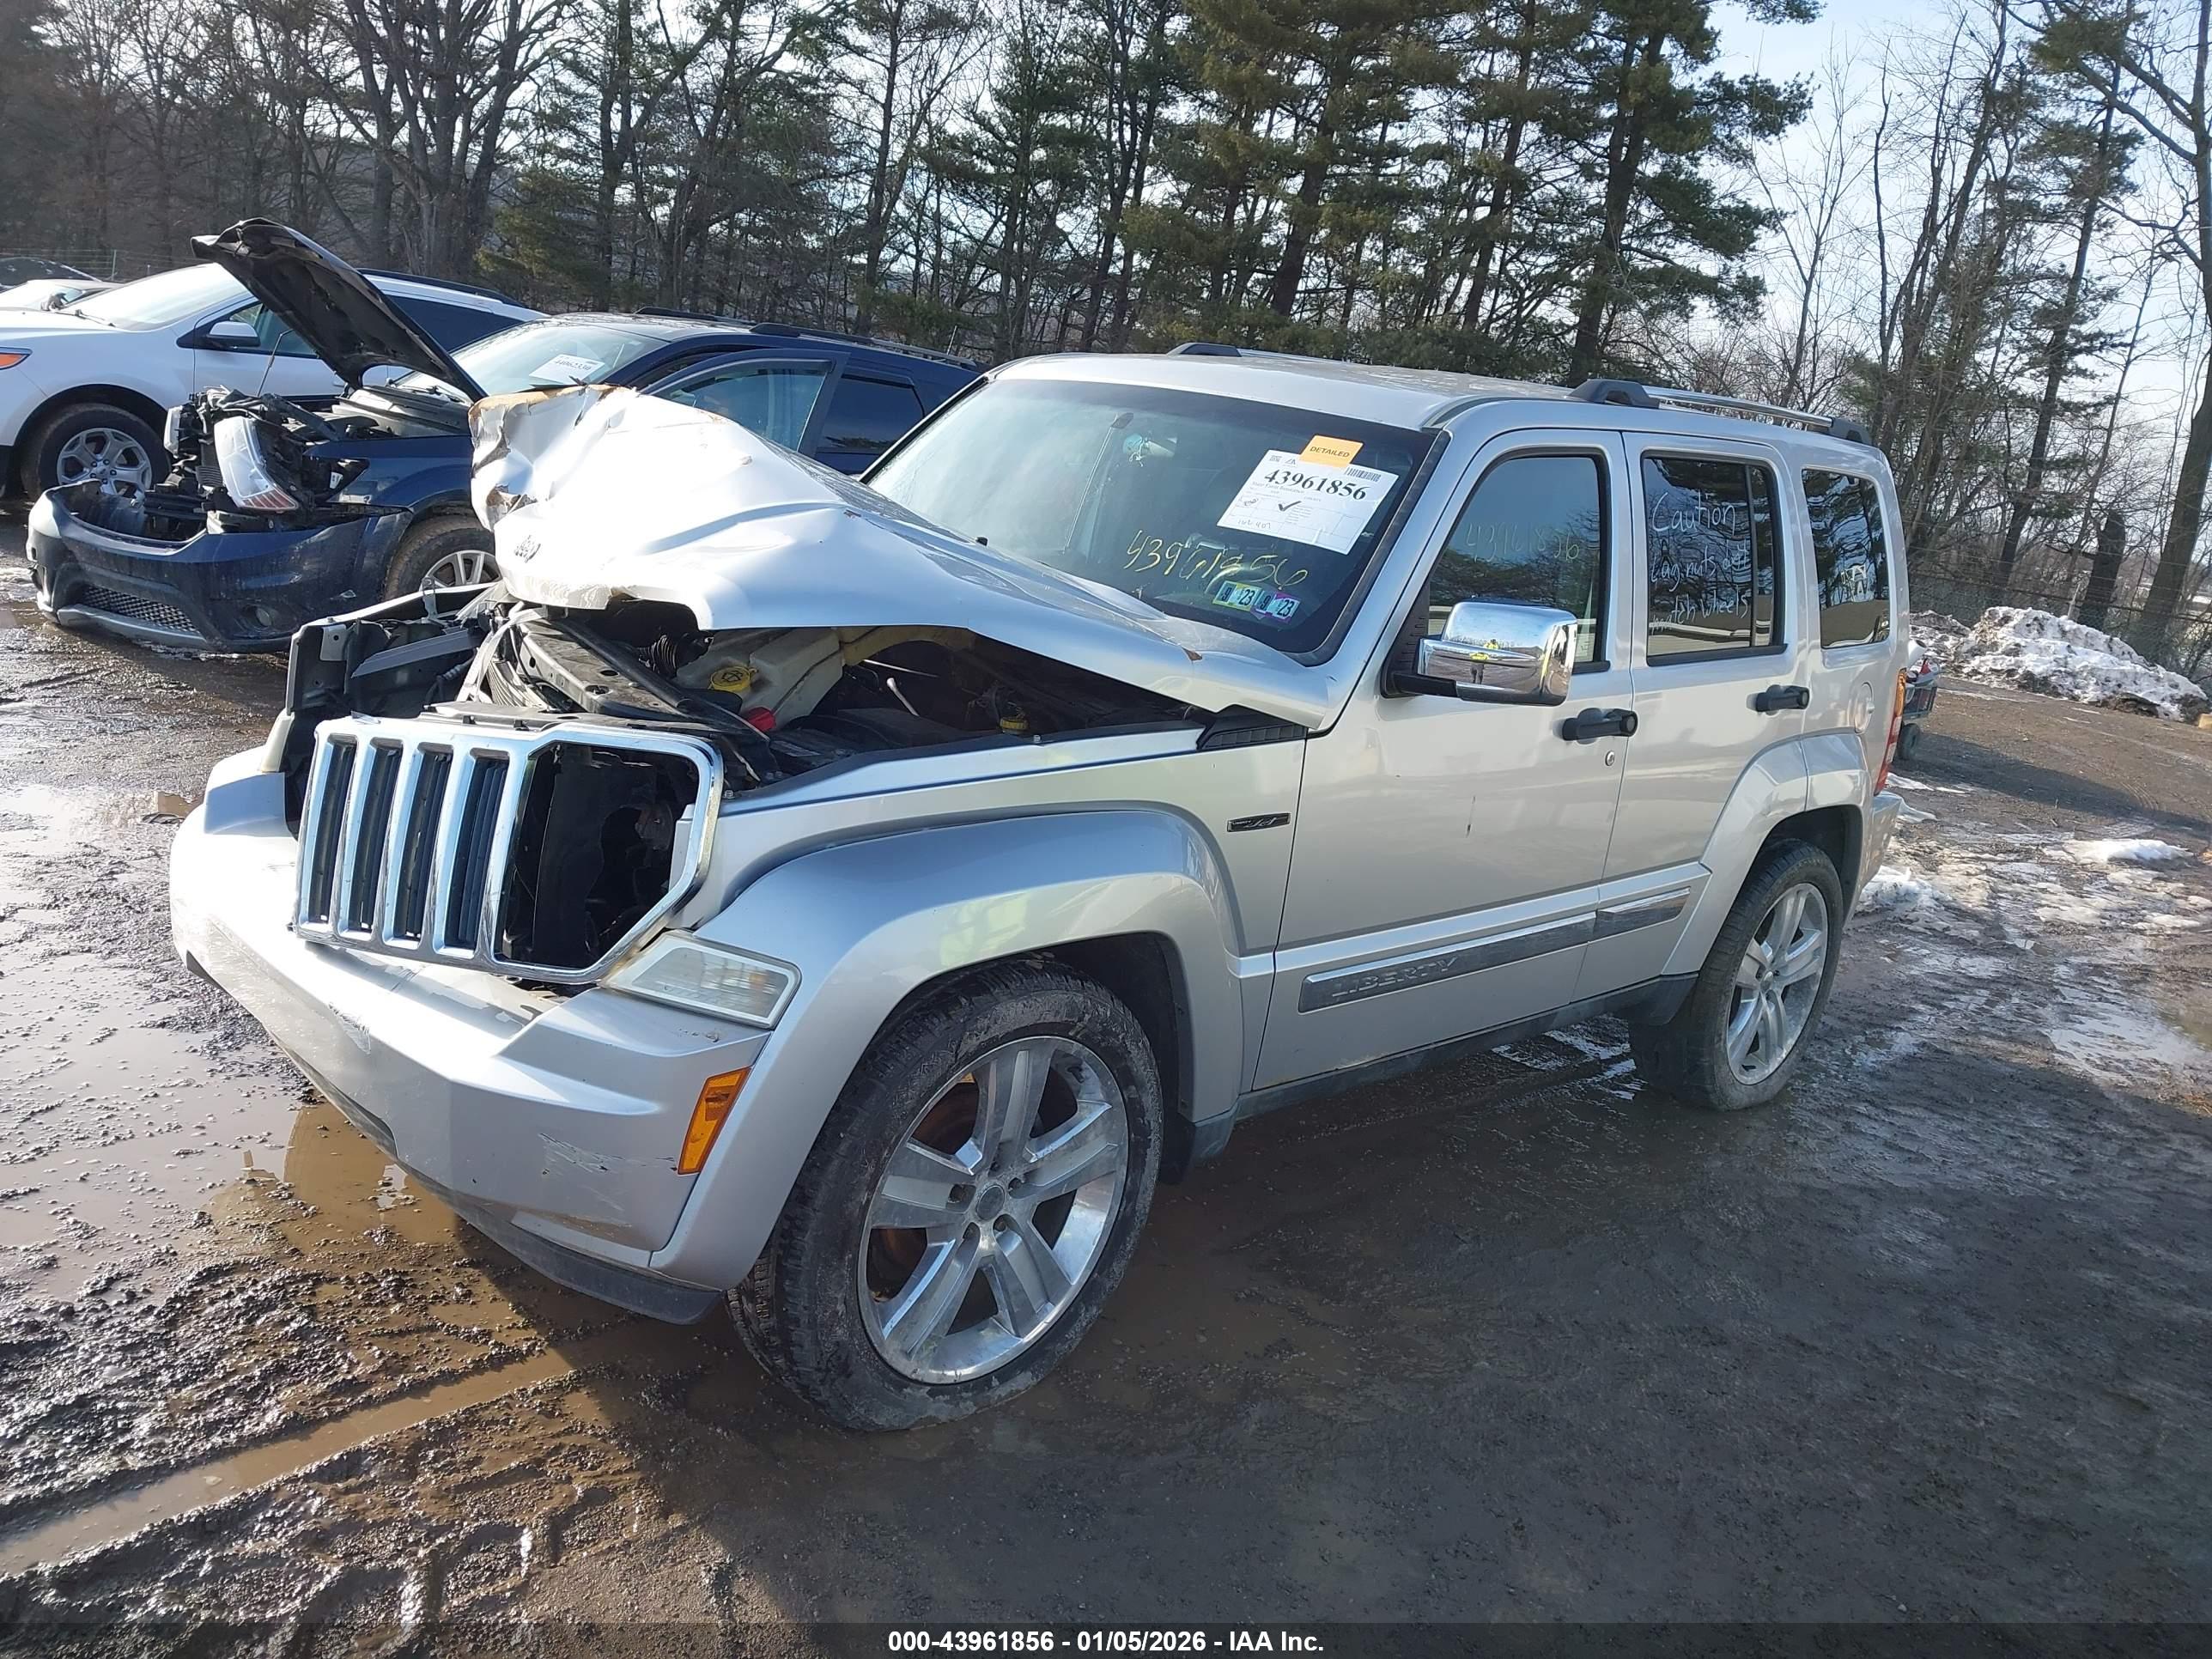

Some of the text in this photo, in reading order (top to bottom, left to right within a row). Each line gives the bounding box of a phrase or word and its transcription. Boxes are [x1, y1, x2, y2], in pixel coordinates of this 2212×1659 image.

[1310, 446, 1350, 458] DETAILED
[1264, 469, 1372, 501] 43961856
[1651, 488, 1736, 537] Caution
[1221, 586, 1255, 606] 9 23
[1260, 595, 1295, 617] 9 23
[1332, 956, 1458, 998] LIBERTY
